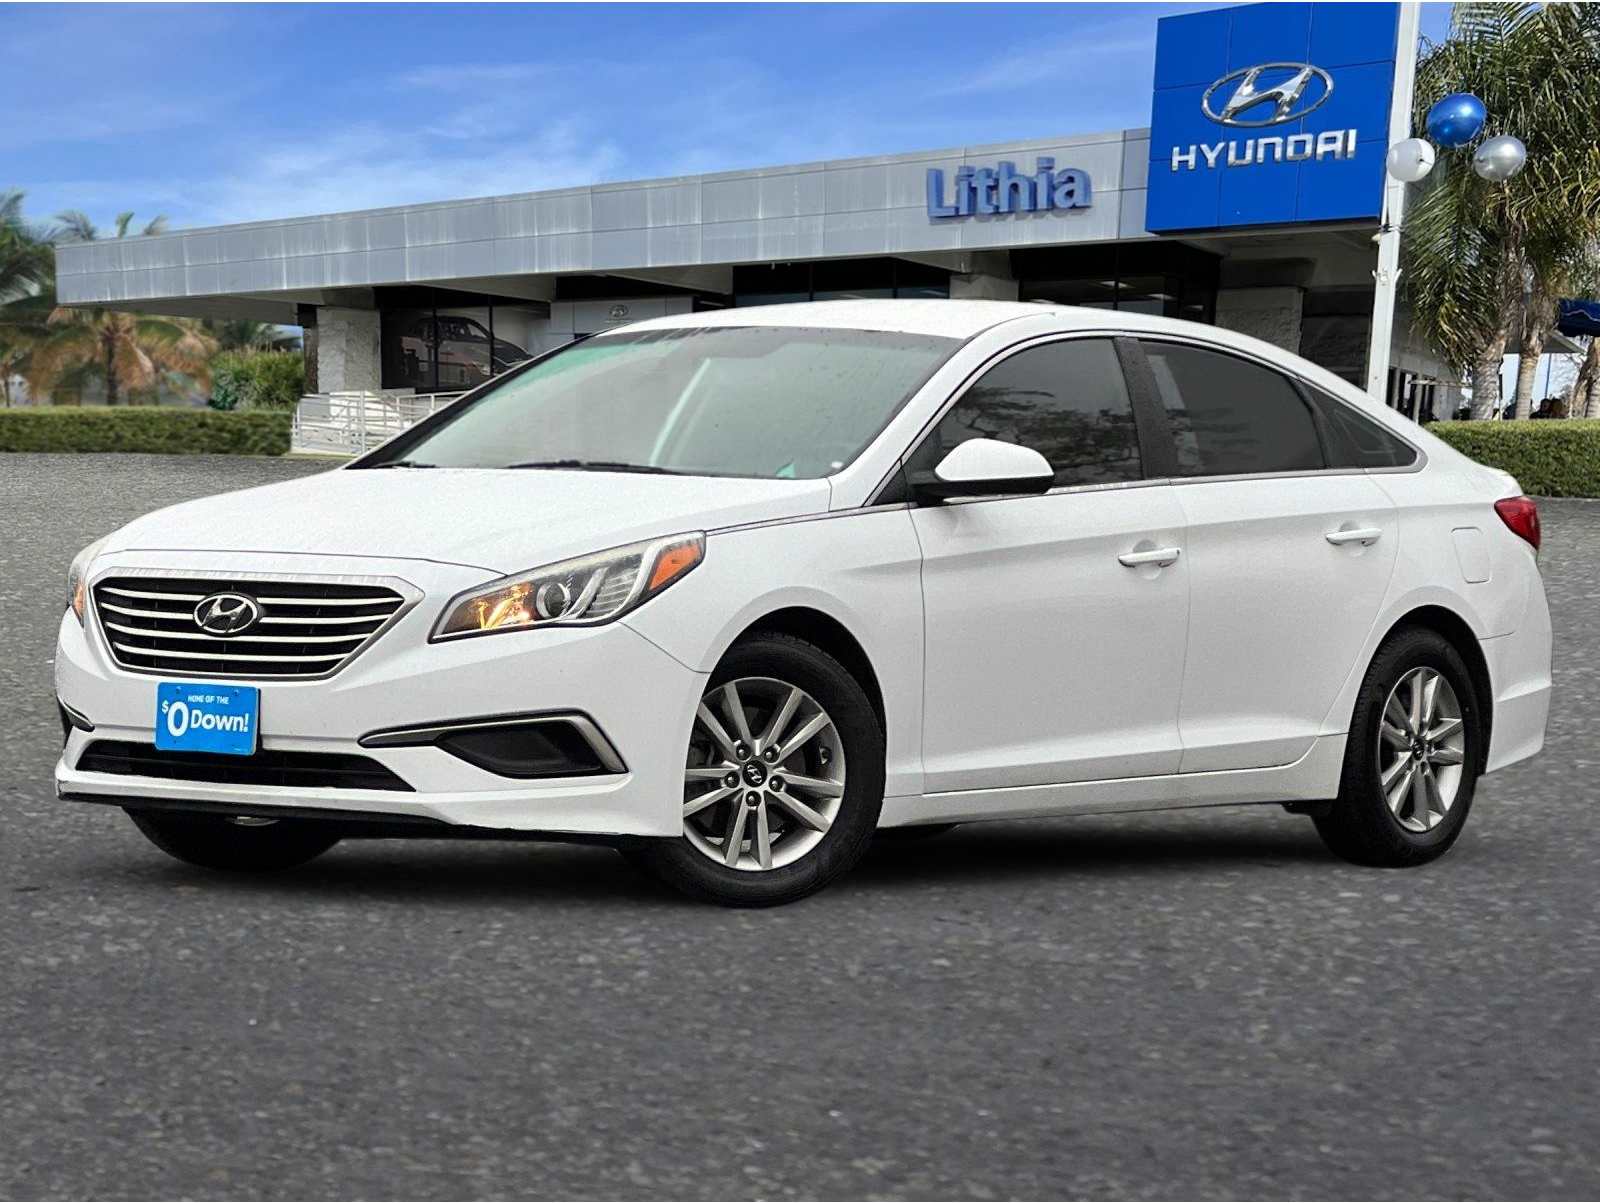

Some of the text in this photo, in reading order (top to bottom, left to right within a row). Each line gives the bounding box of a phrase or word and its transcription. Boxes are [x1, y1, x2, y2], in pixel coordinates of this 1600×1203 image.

[1171, 129, 1357, 171] HYUNDAI
[927, 157, 1092, 218] Lithia
[205, 694, 215, 704] OF
[216, 695, 229, 705] THE
[190, 709, 249, 733] Down!
